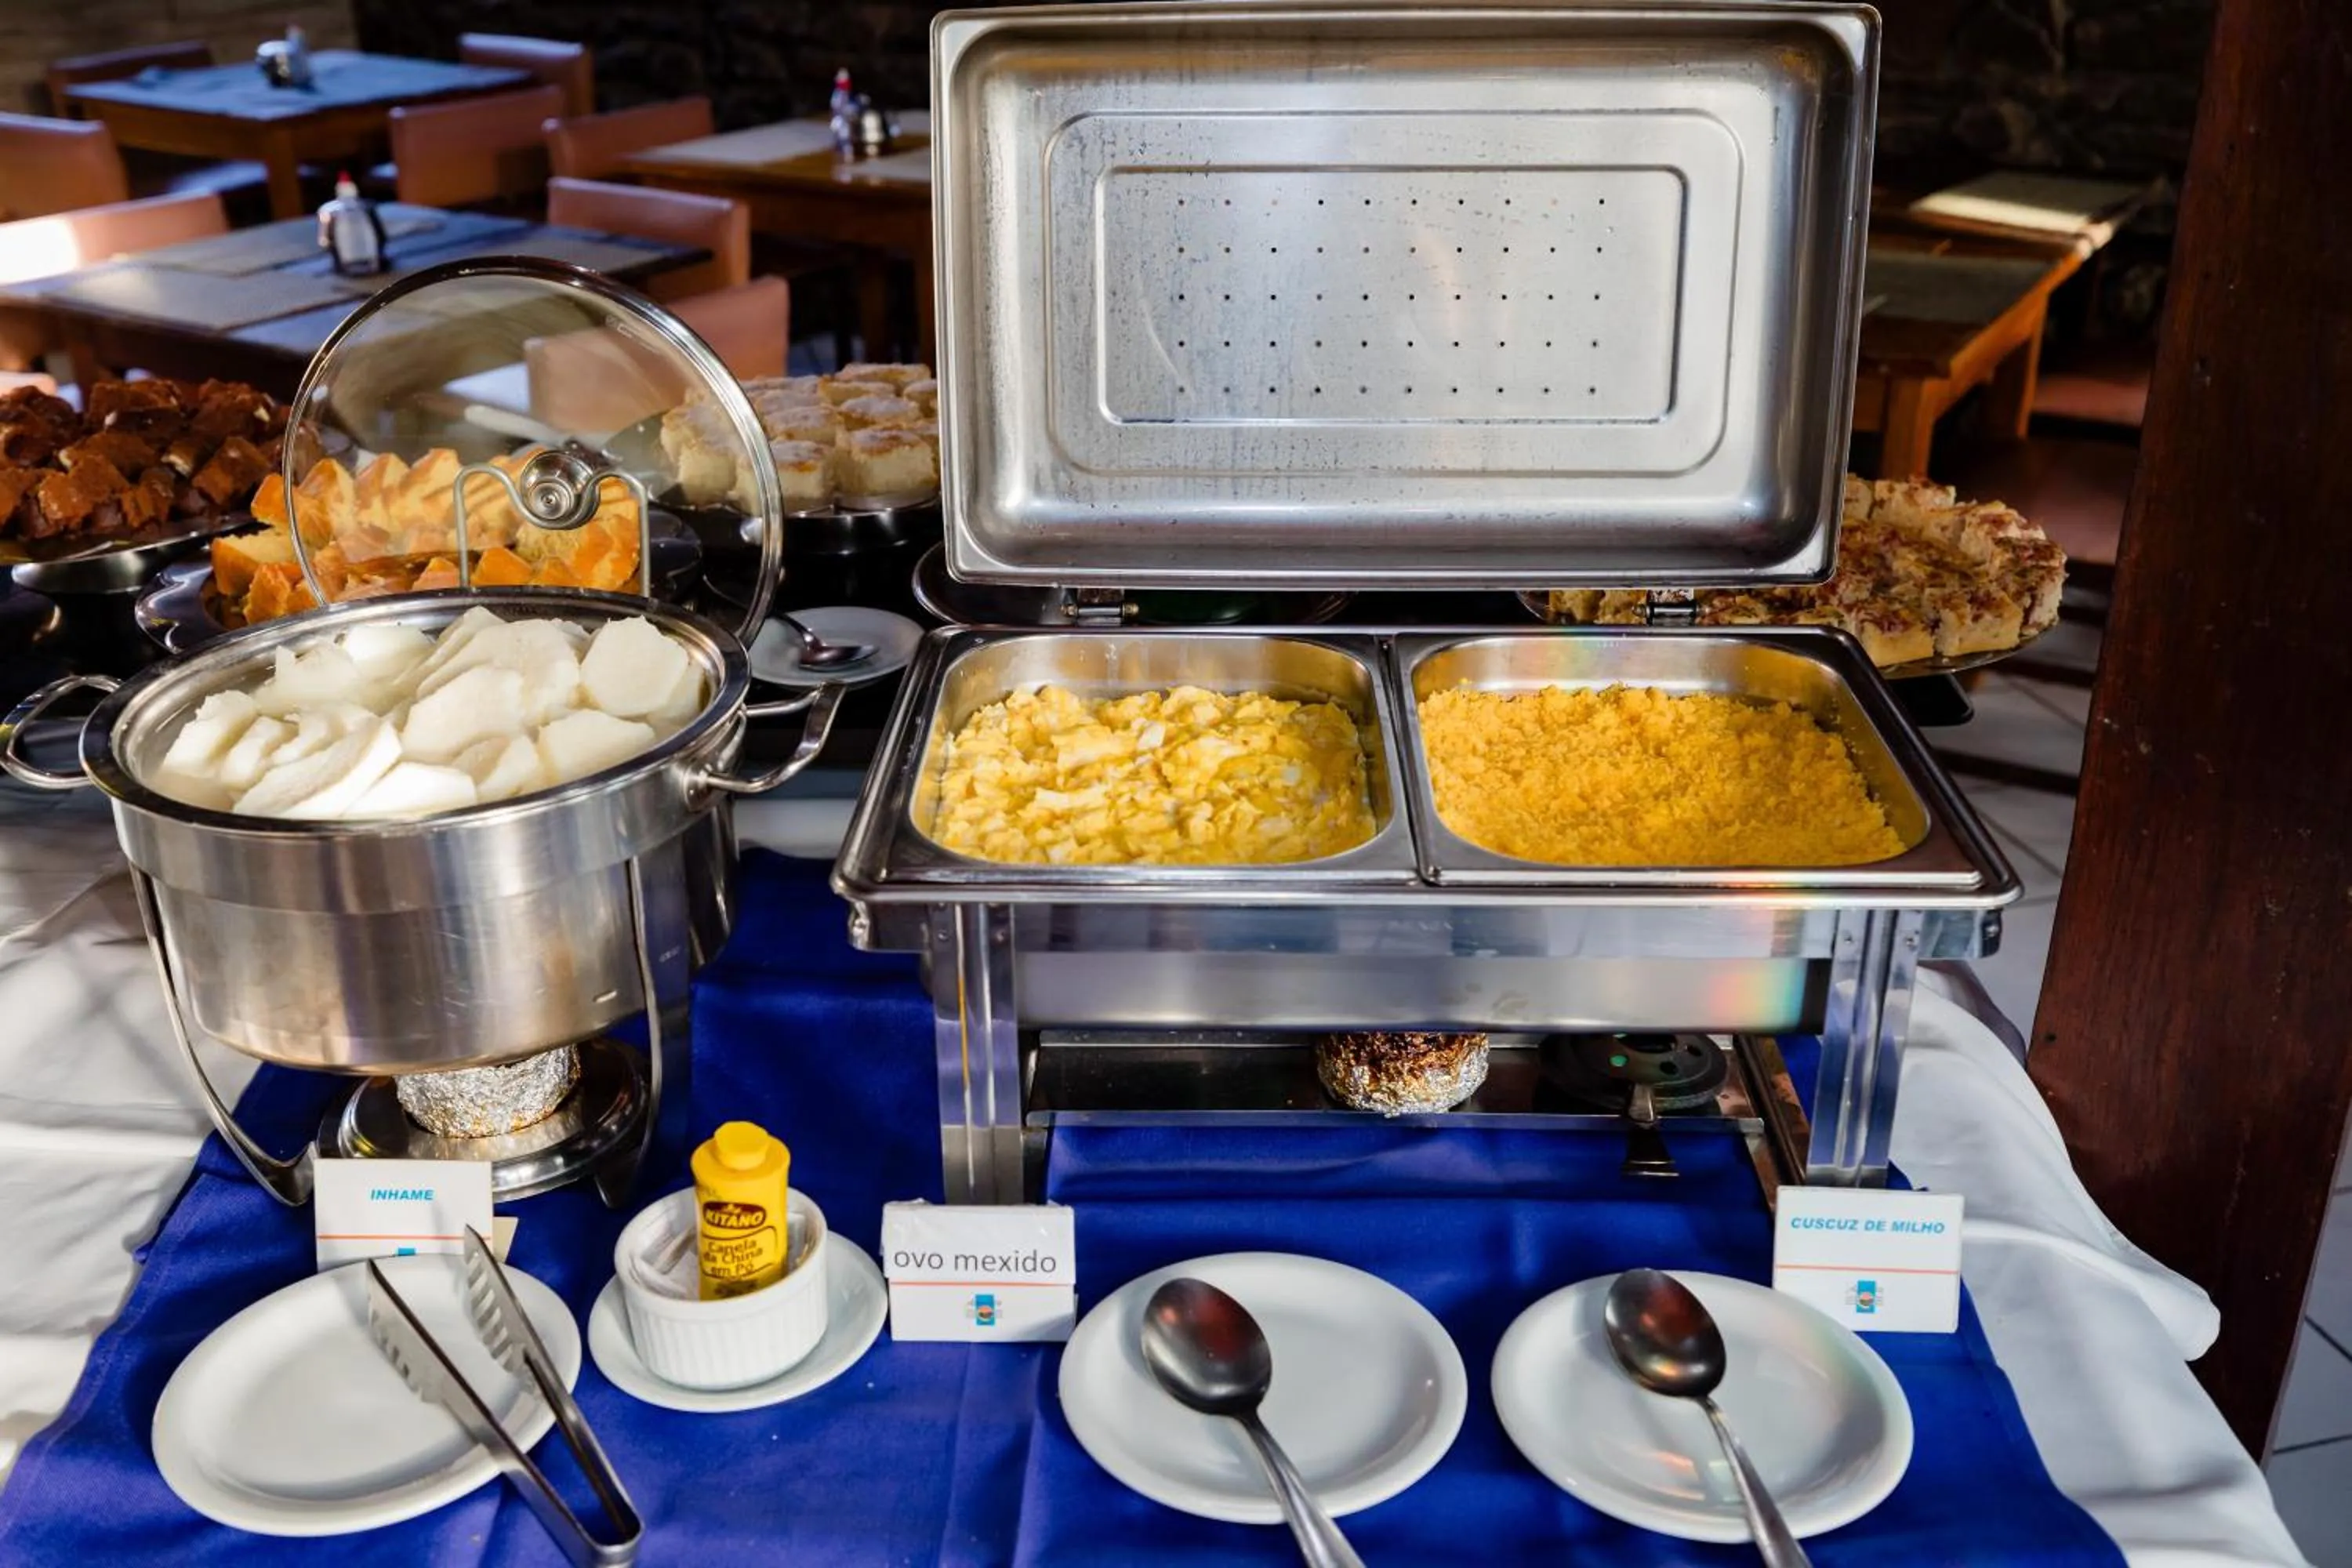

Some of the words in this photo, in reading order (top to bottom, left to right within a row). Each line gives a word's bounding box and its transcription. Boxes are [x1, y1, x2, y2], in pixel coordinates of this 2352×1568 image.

[370, 1189, 434, 1200] INHAME
[706, 1209, 764, 1226] KITANO
[1791, 1217, 1859, 1231] CUSCUZ
[1864, 1220, 1887, 1232] DE
[1890, 1221, 1946, 1234] MILHO
[702, 1250, 717, 1263] da
[722, 1247, 764, 1264] China
[708, 1240, 757, 1255] Canela
[894, 1250, 944, 1270] ovo
[954, 1249, 1057, 1273] mexido
[711, 1266, 731, 1276] em
